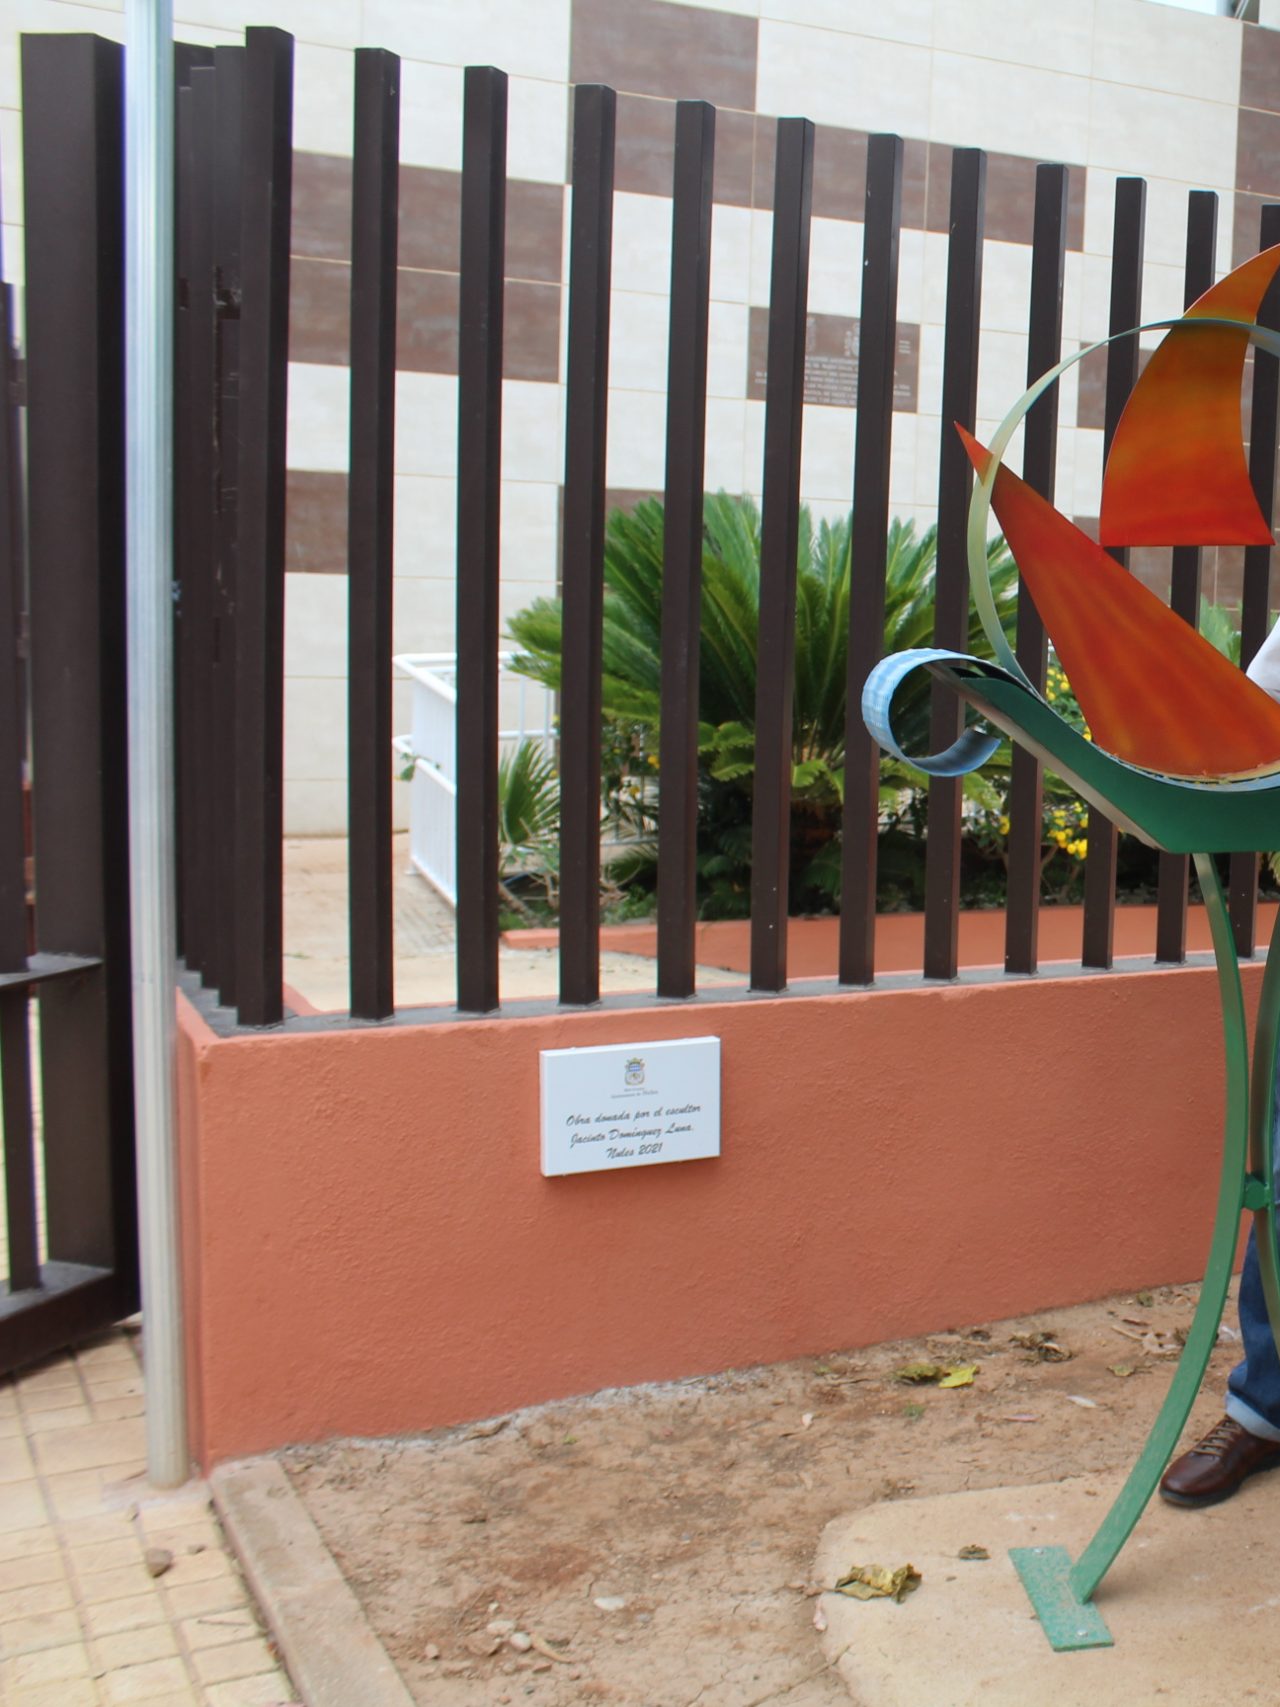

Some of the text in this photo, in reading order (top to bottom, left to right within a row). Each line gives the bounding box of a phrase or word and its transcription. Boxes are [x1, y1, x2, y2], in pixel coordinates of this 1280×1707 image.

[566, 1104, 701, 1126] Obra donada por el escultor
[570, 1132, 605, 1148] Jacinto
[608, 1127, 662, 1141] Domínguez
[606, 1142, 664, 1159] Nules 2021
